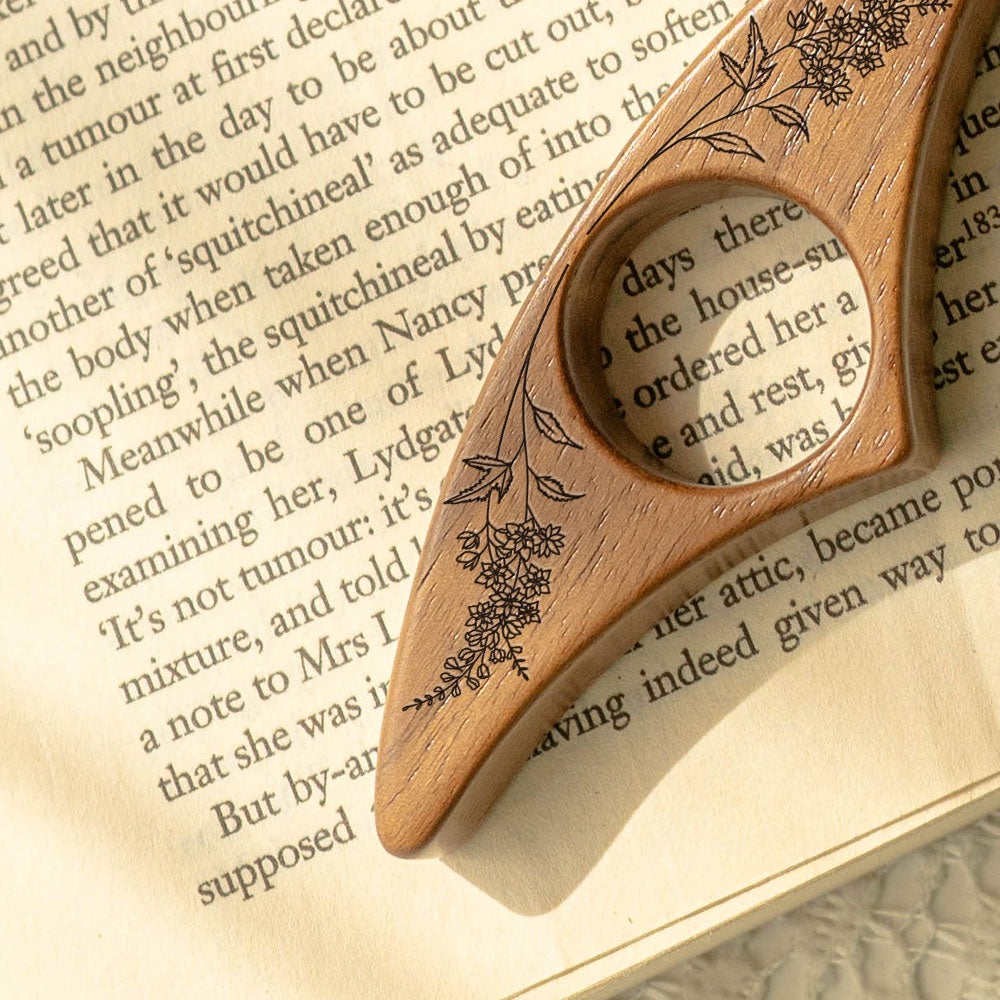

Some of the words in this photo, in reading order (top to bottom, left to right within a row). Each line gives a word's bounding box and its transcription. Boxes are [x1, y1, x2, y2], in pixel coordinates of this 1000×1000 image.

[14, 154, 36, 180] a
[40, 92, 163, 166] tumour
[171, 71, 207, 106] at
[210, 36, 280, 87] first
[86, 208, 157, 258] that
[157, 190, 190, 225] it
[192, 131, 299, 206] would
[298, 105, 382, 158] have
[387, 85, 426, 116] to
[427, 61, 476, 96] be
[483, 29, 540, 71] cut
[76, 384, 266, 492] Meanwhile
[272, 342, 371, 398] when
[370, 283, 488, 354] Nancy
[97, 603, 166, 651] ‘It’s
[170, 576, 235, 623] not
[237, 514, 374, 592] tumour:
[377, 482, 433, 528] it’s
[631, 319, 767, 409] ordered
[763, 301, 828, 347] her
[835, 290, 860, 316] a
[138, 727, 161, 754] a
[165, 688, 245, 742] note
[251, 670, 290, 701] to
[292, 631, 370, 684] Mrs
[196, 804, 357, 907] supposed
[638, 619, 760, 704] indeed
[773, 583, 869, 654] given
[876, 542, 946, 592] way
[962, 521, 1000, 554] to
